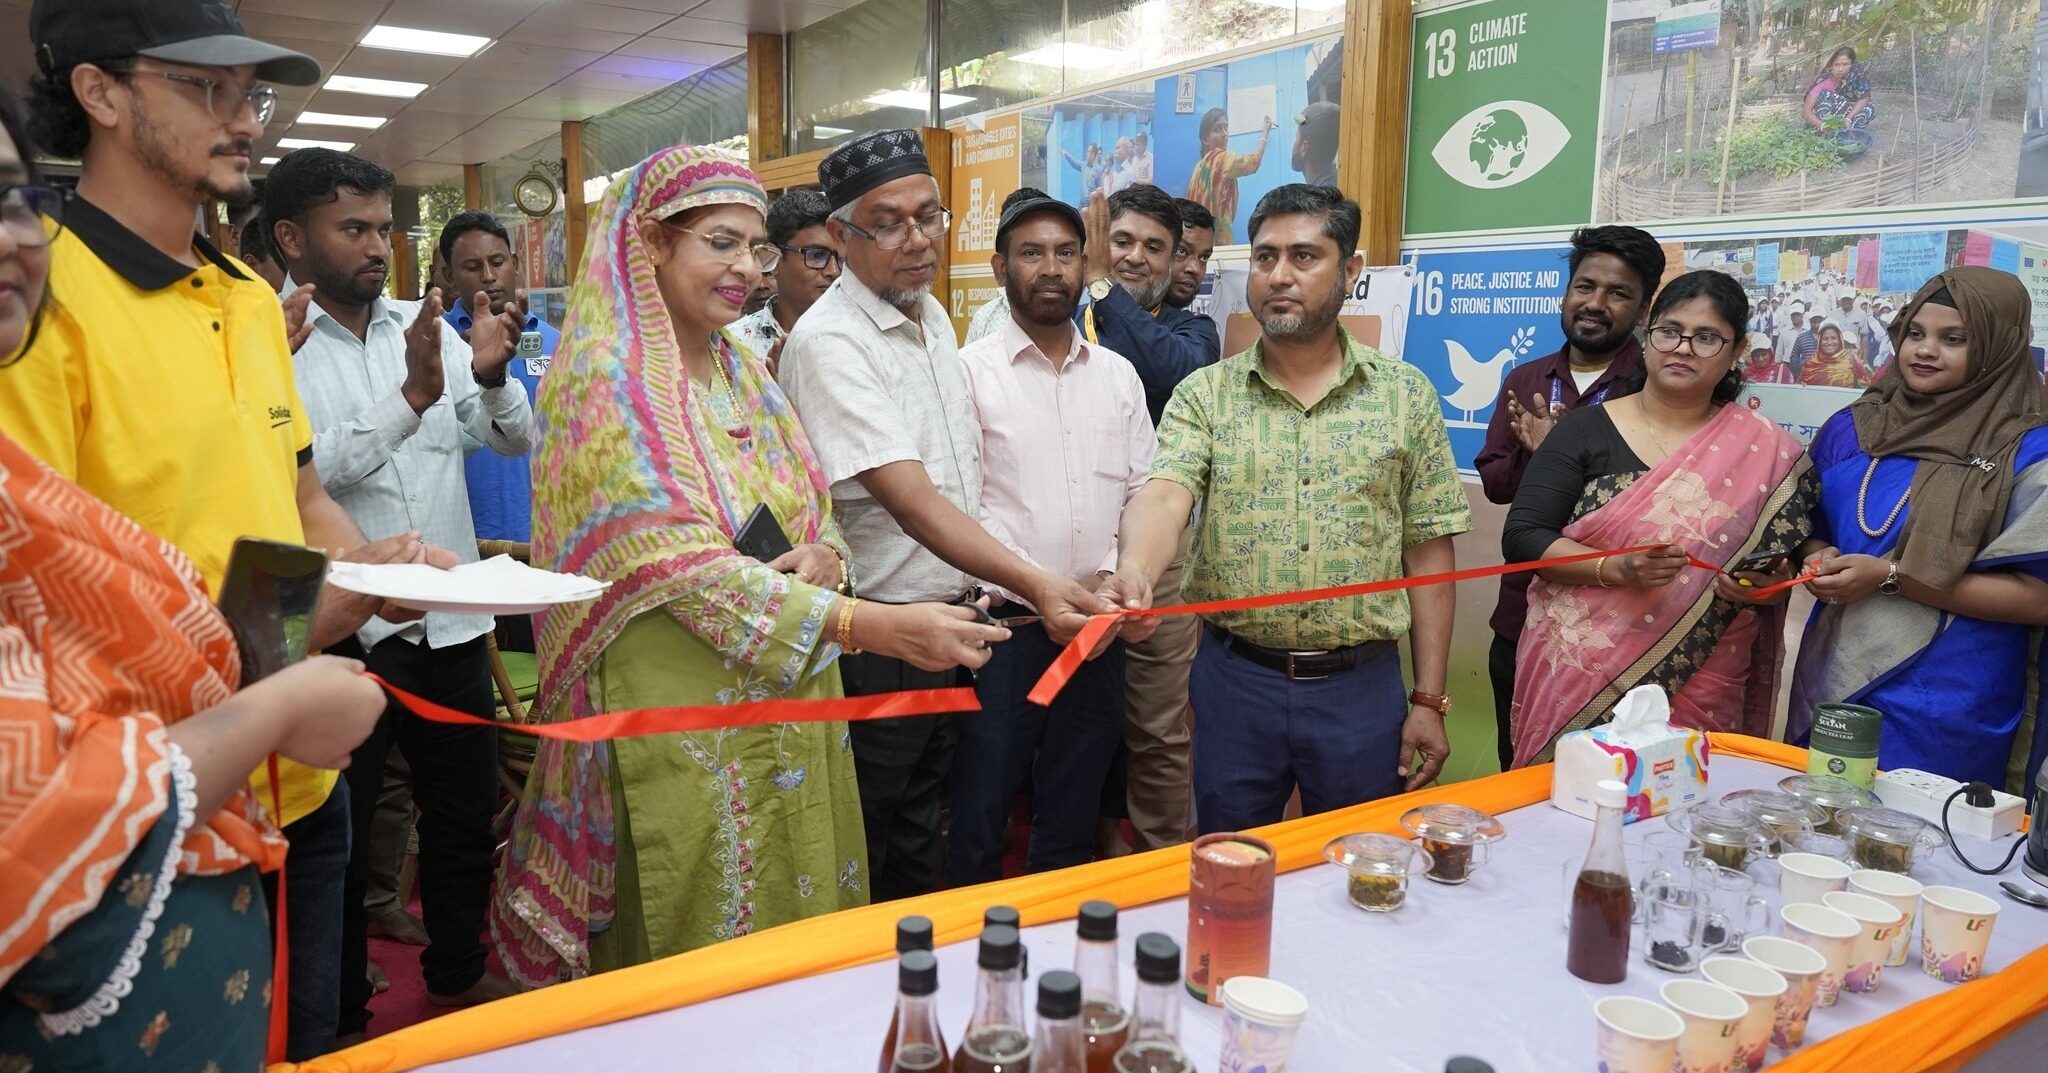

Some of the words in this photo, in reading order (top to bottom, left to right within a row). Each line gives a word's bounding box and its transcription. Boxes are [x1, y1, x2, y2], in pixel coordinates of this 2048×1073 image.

[1469, 12, 1527, 44] CLIMATE
[1425, 28, 1456, 79] 13
[1467, 42, 1518, 72] ACTION
[1000, 125, 1017, 141] CITIES
[952, 137, 963, 168] 11
[977, 143, 1014, 163] COMMUNITIES
[1413, 270, 1443, 316] 16
[1451, 273, 1487, 291] PEACE,
[1489, 271, 1532, 289] JUSTICE
[1535, 271, 1560, 288] AND
[952, 288, 964, 317] 12
[1450, 297, 1490, 314] STRONG
[1874, 929, 1892, 941] LF
[1966, 919, 1986, 931] LF
